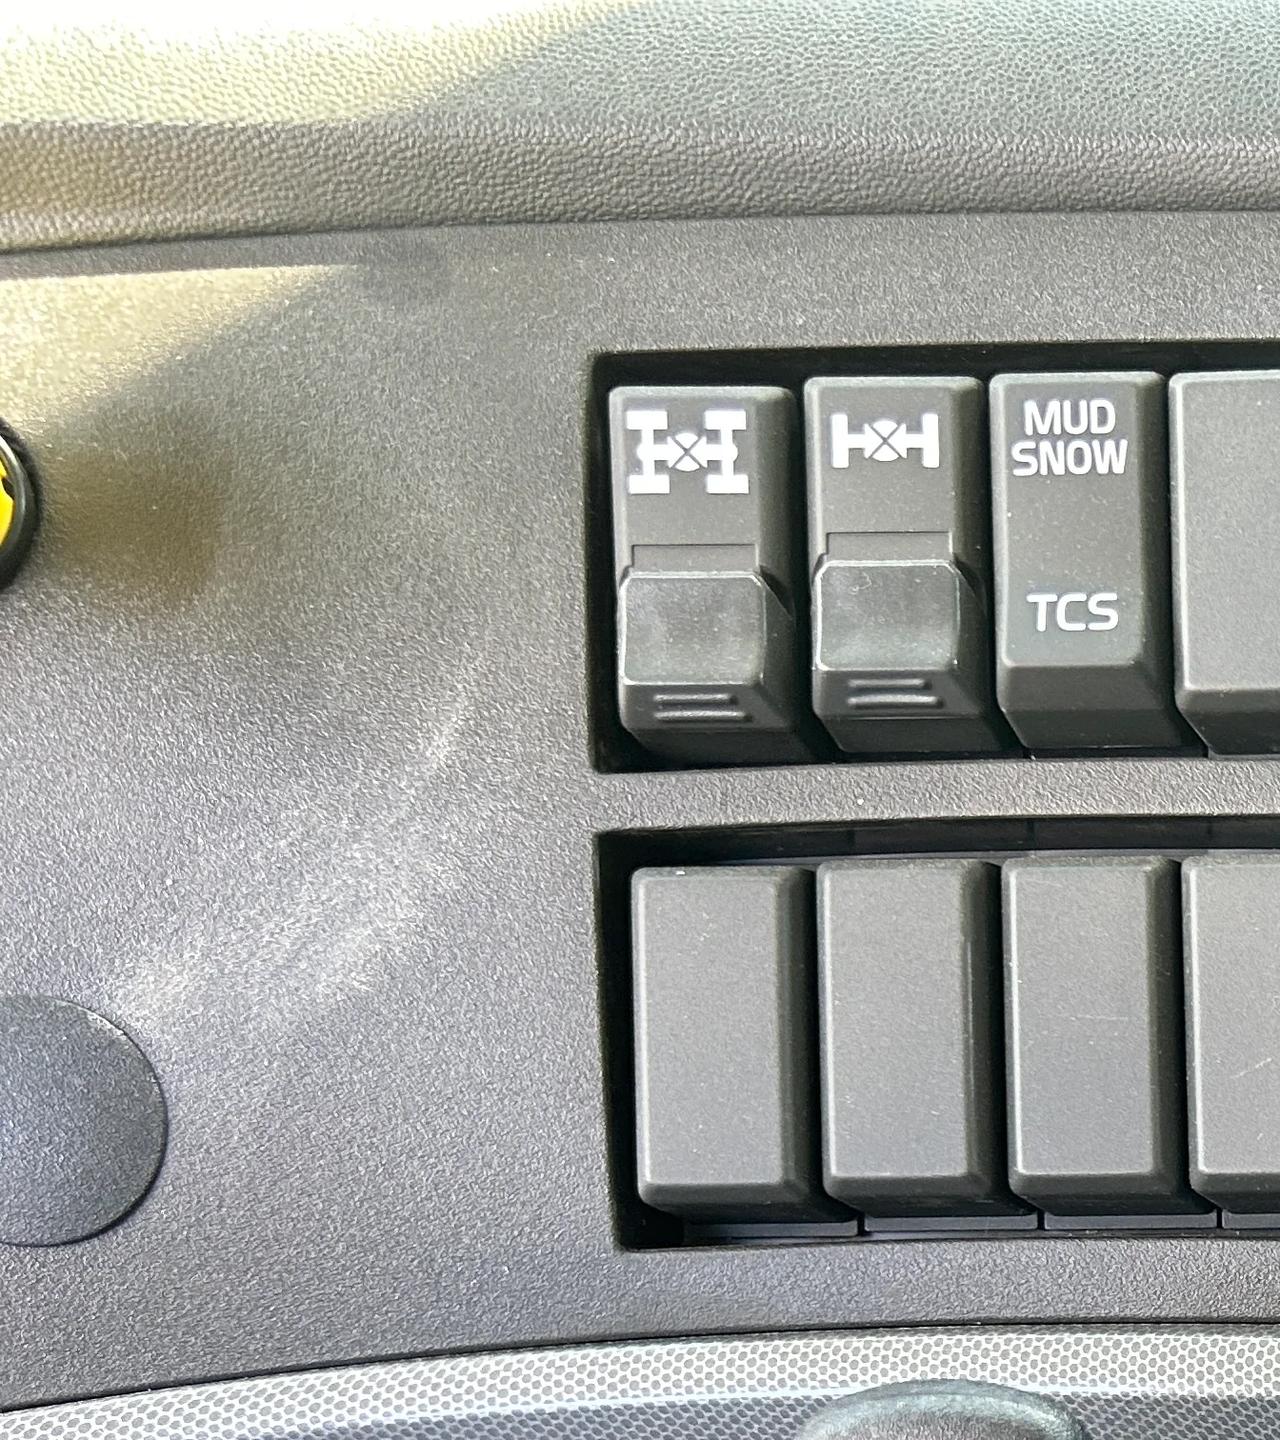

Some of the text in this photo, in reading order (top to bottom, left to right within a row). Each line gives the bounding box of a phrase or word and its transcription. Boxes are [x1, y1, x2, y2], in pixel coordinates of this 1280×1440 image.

[1023, 398, 1116, 435] MUD
[1011, 438, 1128, 476] SNOW
[1027, 593, 1119, 633] TCS
